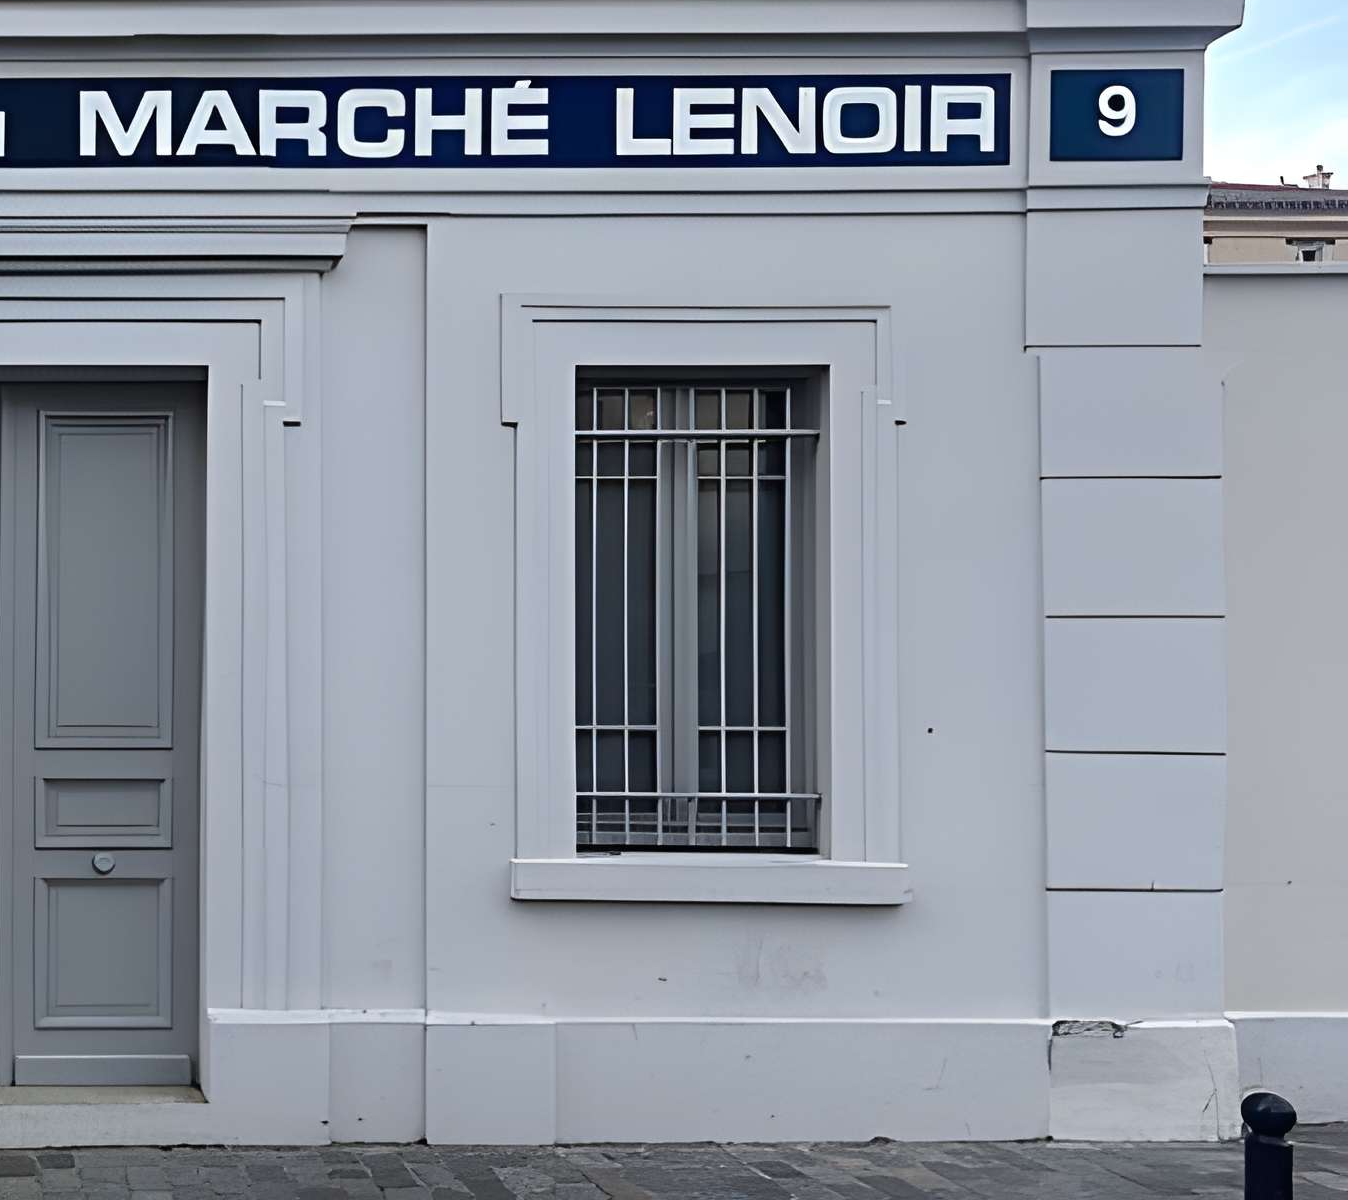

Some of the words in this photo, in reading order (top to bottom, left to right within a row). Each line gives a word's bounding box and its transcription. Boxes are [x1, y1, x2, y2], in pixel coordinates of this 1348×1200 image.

[79, 79, 549, 159] MARCHÉ
[614, 84, 995, 156] LENOIR
[1098, 85, 1137, 137] 9
